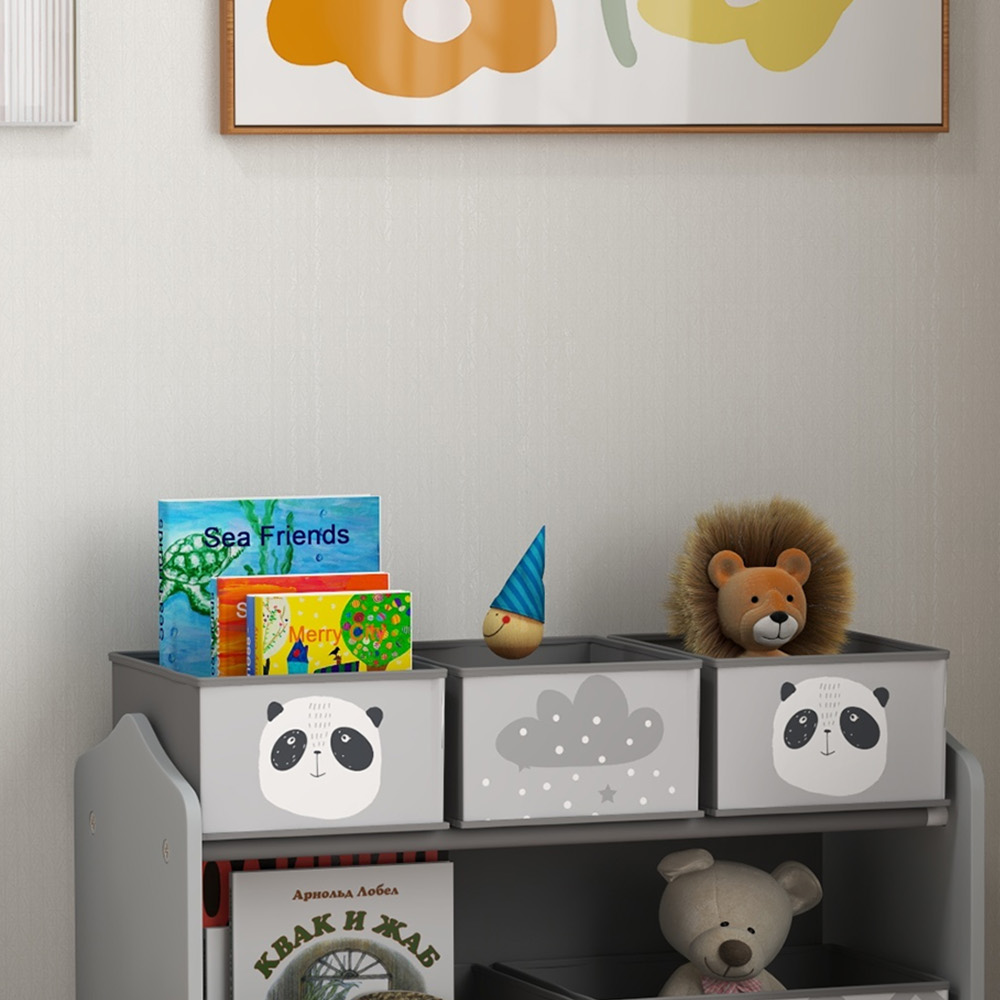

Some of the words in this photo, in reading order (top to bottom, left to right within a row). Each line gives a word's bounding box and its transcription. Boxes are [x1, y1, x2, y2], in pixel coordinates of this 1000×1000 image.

[204, 526, 250, 548] Sea
[260, 524, 350, 547] Friends
[289, 625, 342, 648] Merry
[292, 889, 353, 902] Арнольд
[357, 883, 399, 898] Лобел
[253, 912, 336, 980] КВАК
[343, 910, 367, 931] И
[372, 914, 441, 968] ЖАБ
